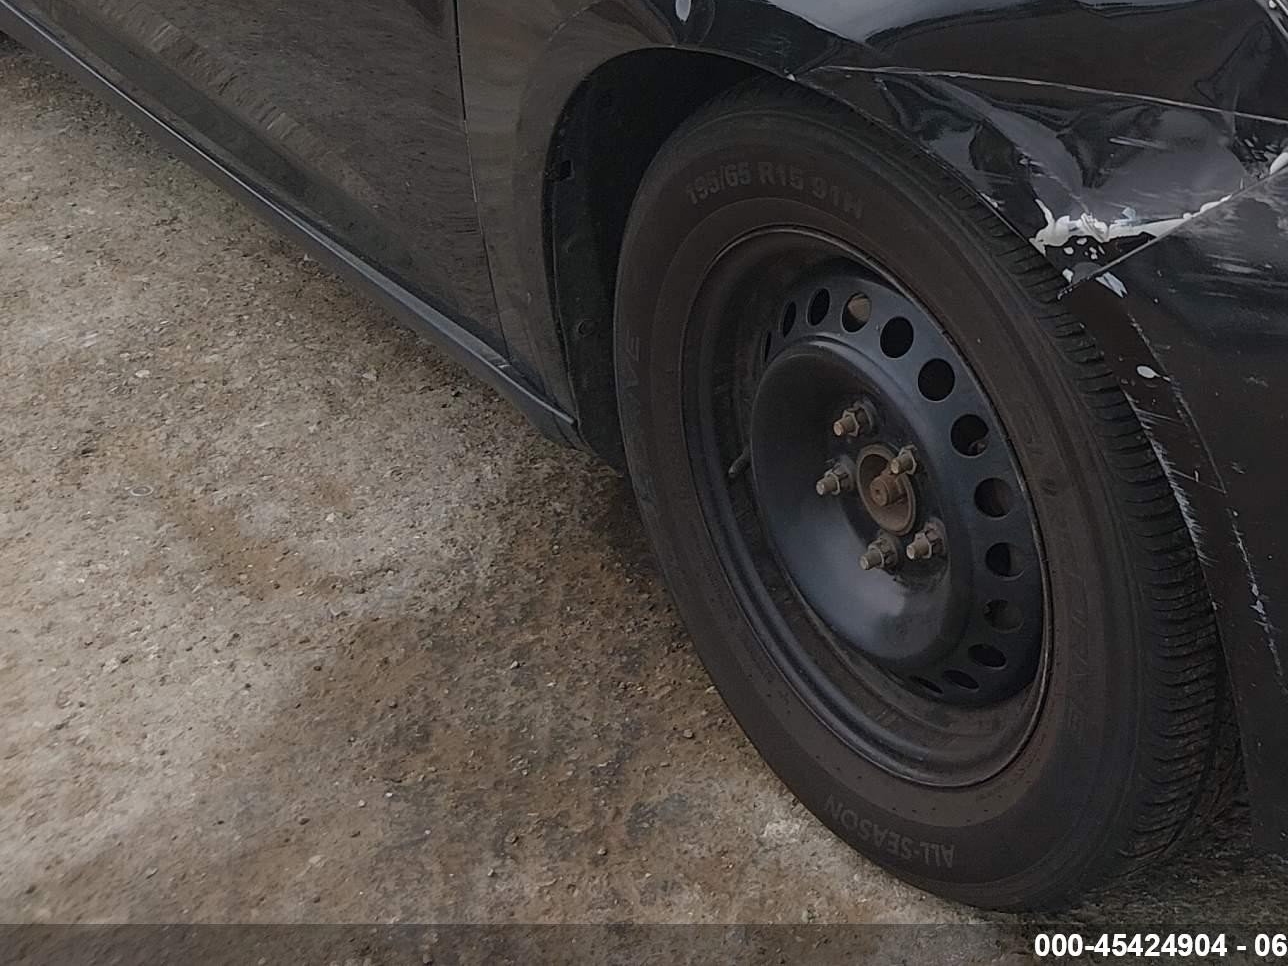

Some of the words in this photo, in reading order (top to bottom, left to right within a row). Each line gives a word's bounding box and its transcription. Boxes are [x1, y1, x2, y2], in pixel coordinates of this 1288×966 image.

[686, 161, 752, 205] 195/65
[757, 161, 804, 191] R15
[823, 793, 956, 869] ALL-SEASON
